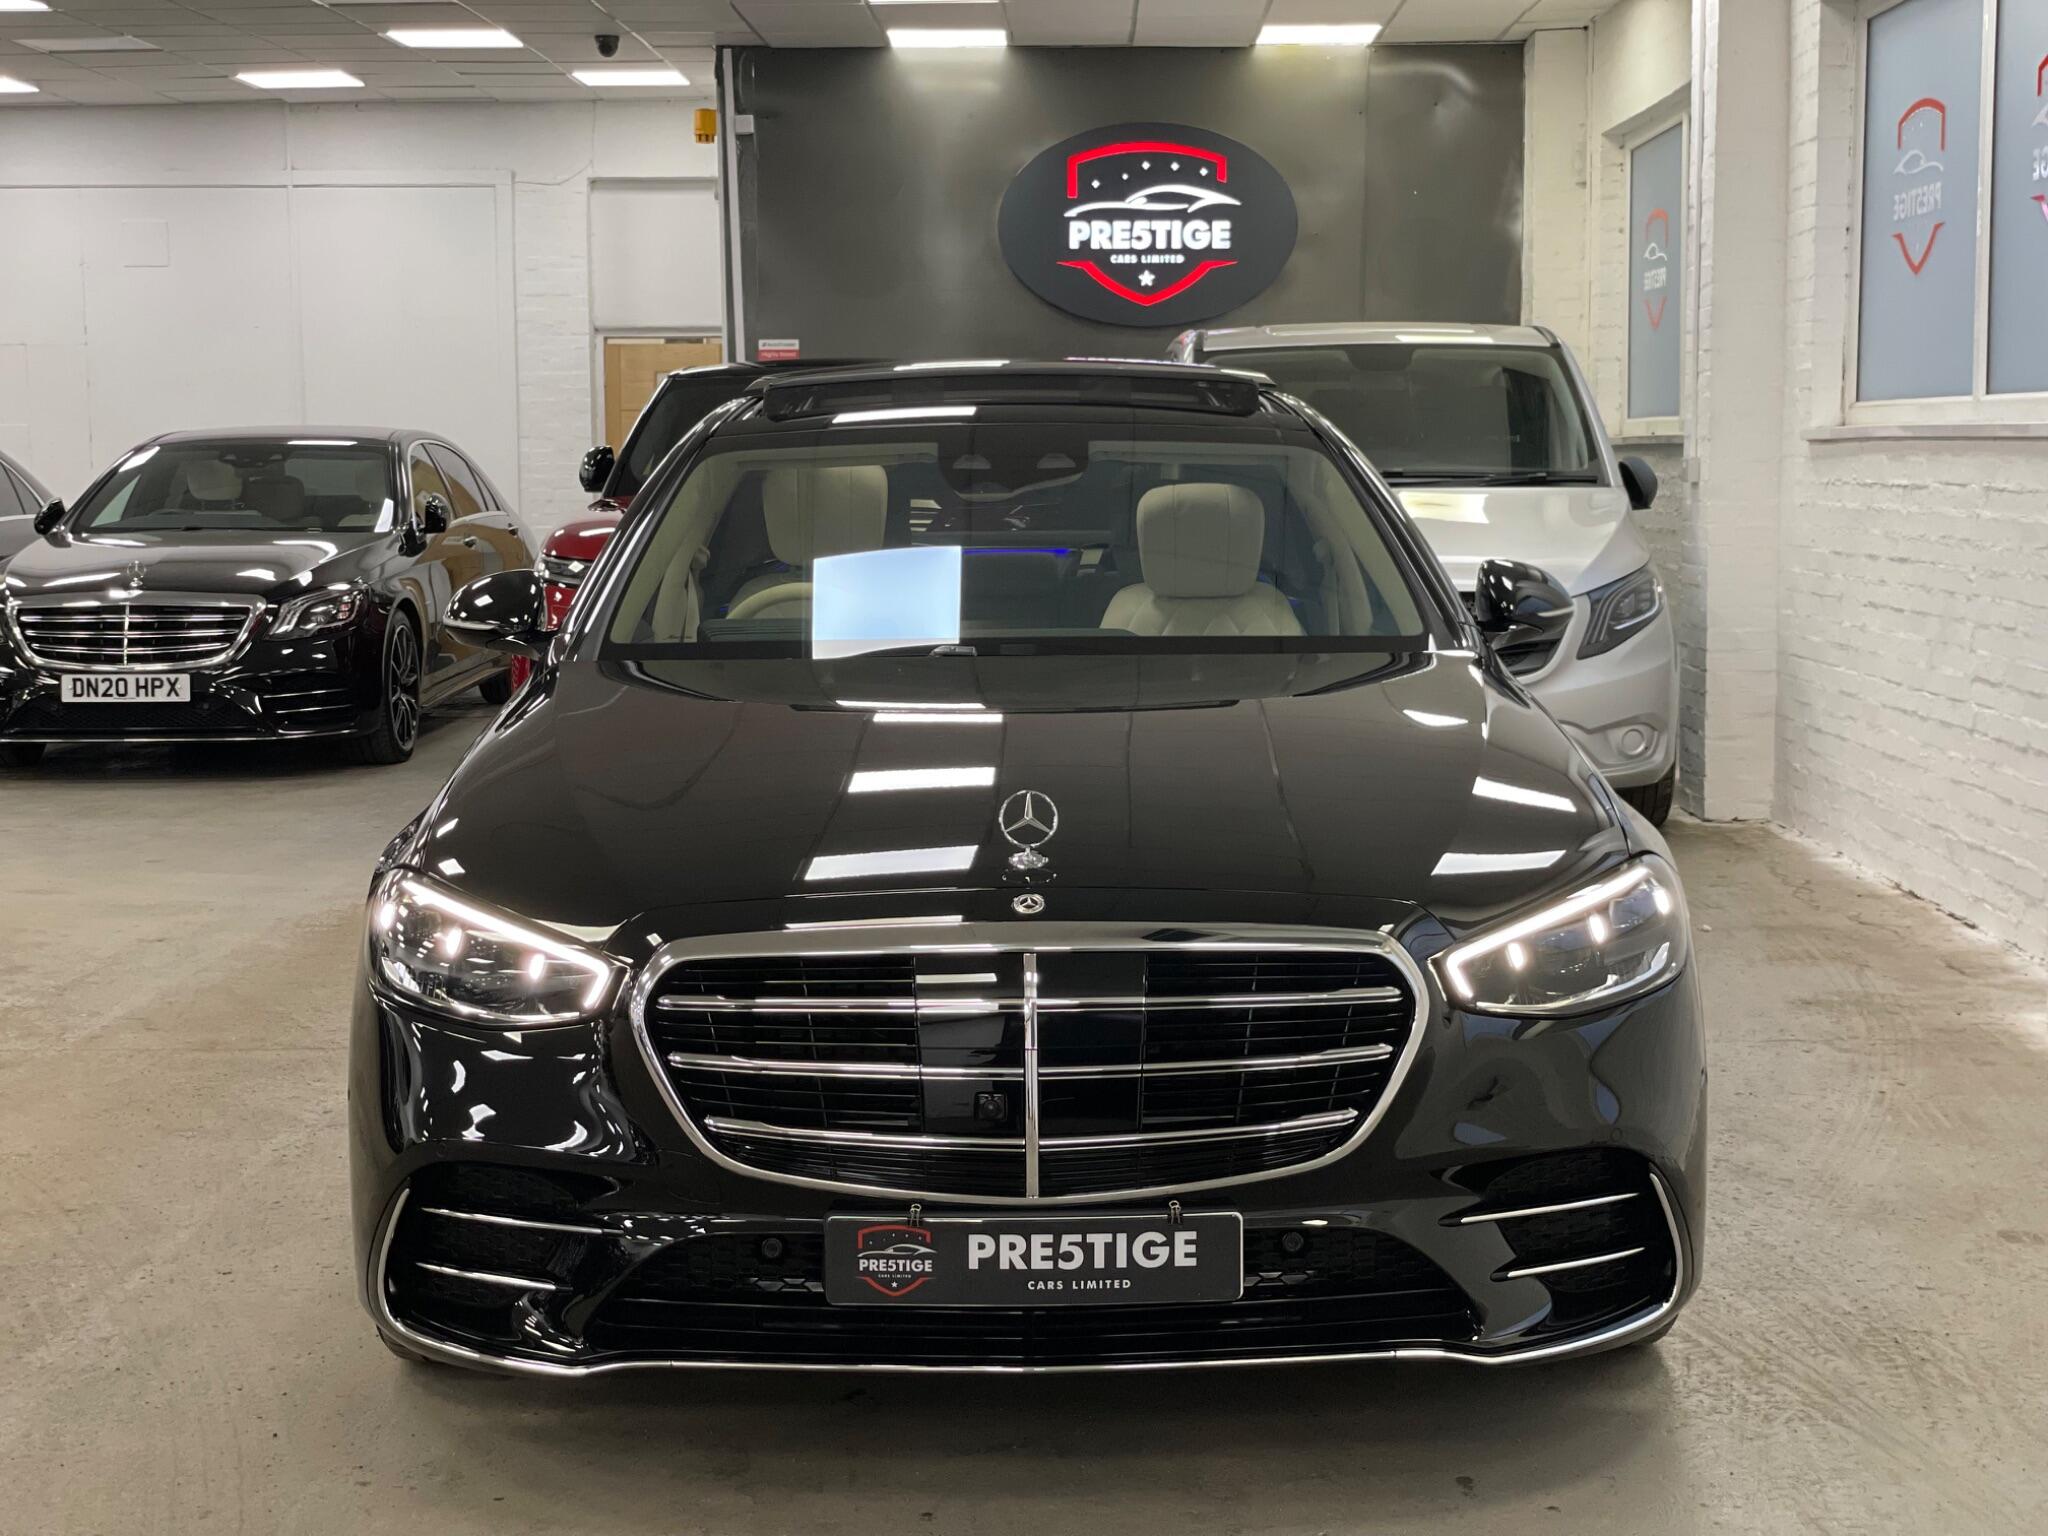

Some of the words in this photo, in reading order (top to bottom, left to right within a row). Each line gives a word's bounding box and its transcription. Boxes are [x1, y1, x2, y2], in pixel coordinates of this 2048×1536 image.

[1110, 254, 1138, 264] CARS
[1141, 254, 1185, 264] LIMITED
[72, 677, 129, 698] DN20
[135, 677, 180, 697] HPX
[1027, 1280, 1064, 1290] CARS
[1072, 1279, 1132, 1290] LIMITED
